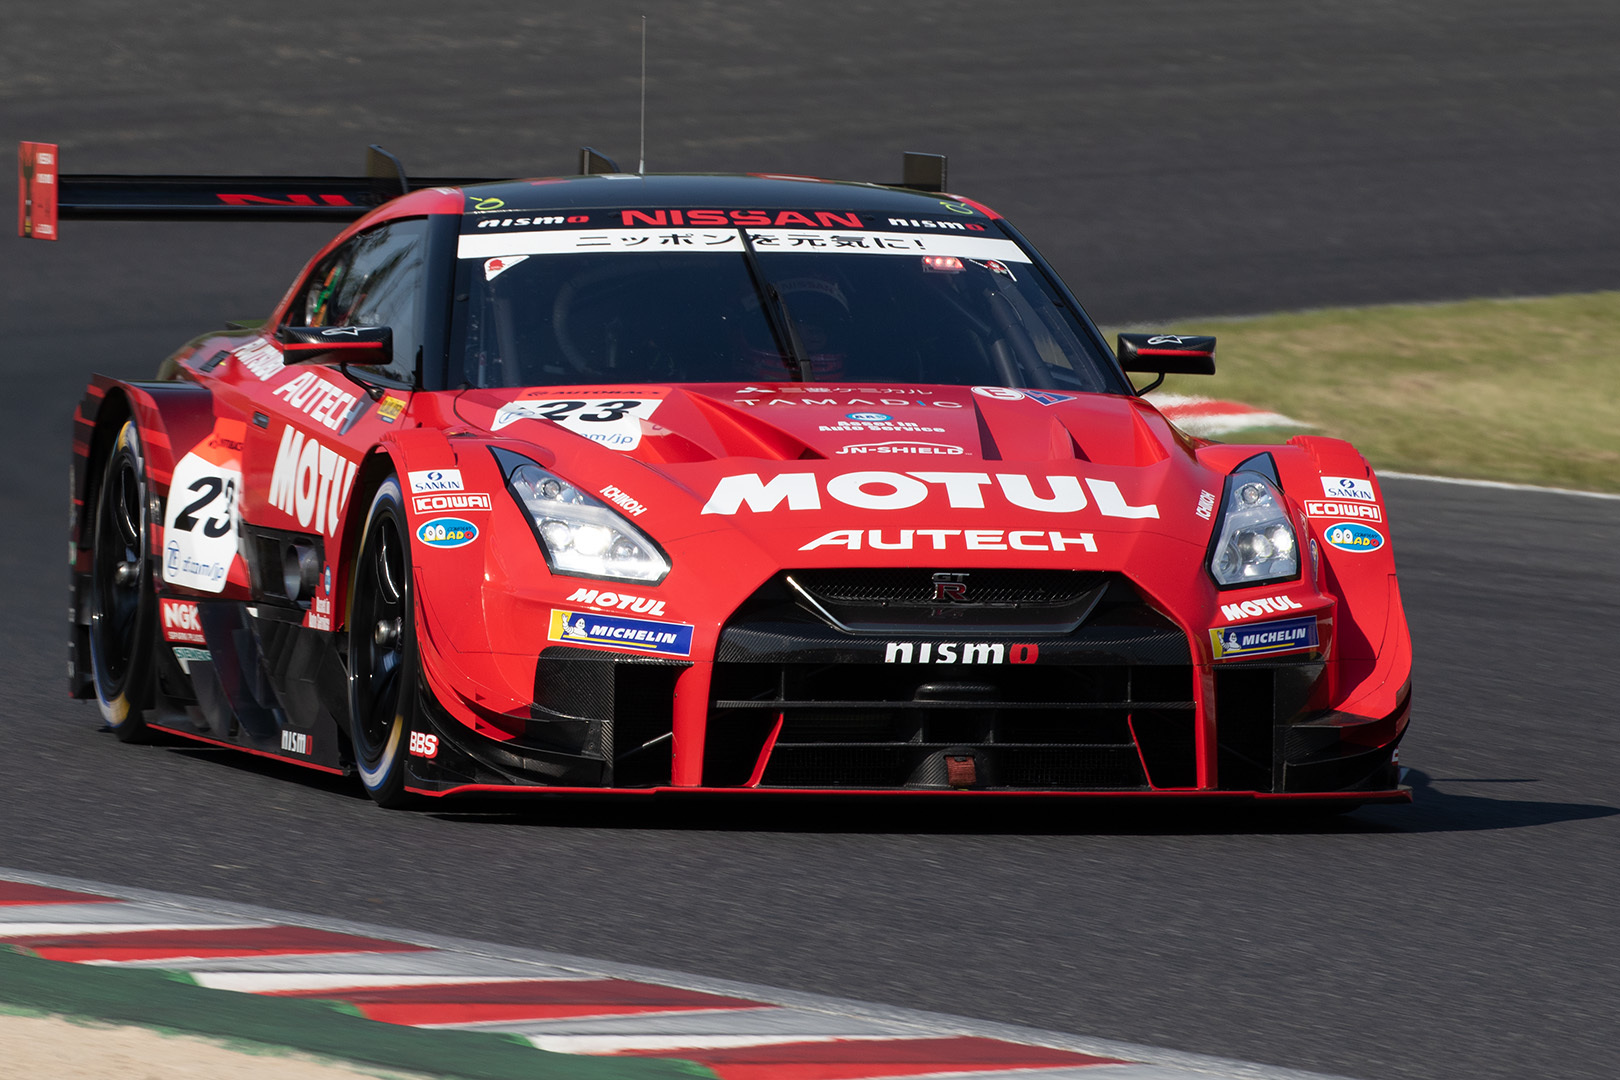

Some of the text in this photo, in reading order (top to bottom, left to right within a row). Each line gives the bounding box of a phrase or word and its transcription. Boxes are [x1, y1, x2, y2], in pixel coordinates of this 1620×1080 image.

[477, 215, 590, 228] nismo
[621, 209, 864, 228] NISSAN
[888, 217, 985, 232] nismo
[272, 371, 364, 436] AUTECH
[537, 400, 642, 422] 23
[733, 398, 963, 409] TAMADIC
[867, 425, 946, 433] Service
[835, 446, 964, 455] JN-SHIELD
[268, 423, 359, 538] MOTU
[415, 481, 460, 491] SANKIN
[416, 496, 489, 511] KOIWAI
[599, 484, 648, 517] ICHIKOH
[700, 471, 1160, 519] MOTUL
[1196, 489, 1215, 520] ICHIKOH
[1328, 487, 1372, 500] SANKIN
[173, 476, 235, 539] 23
[1308, 503, 1379, 519] KOIWAI
[798, 529, 1098, 552] AUTECH
[566, 588, 666, 617] MOTUL
[1220, 595, 1303, 621] MOTUL
[163, 603, 202, 631] NGK
[590, 625, 677, 644] MICHELIN
[1242, 627, 1306, 646] MICHELIN
[884, 642, 1039, 664] nismo
[281, 729, 313, 756] nismo
[409, 730, 439, 758] BBS
